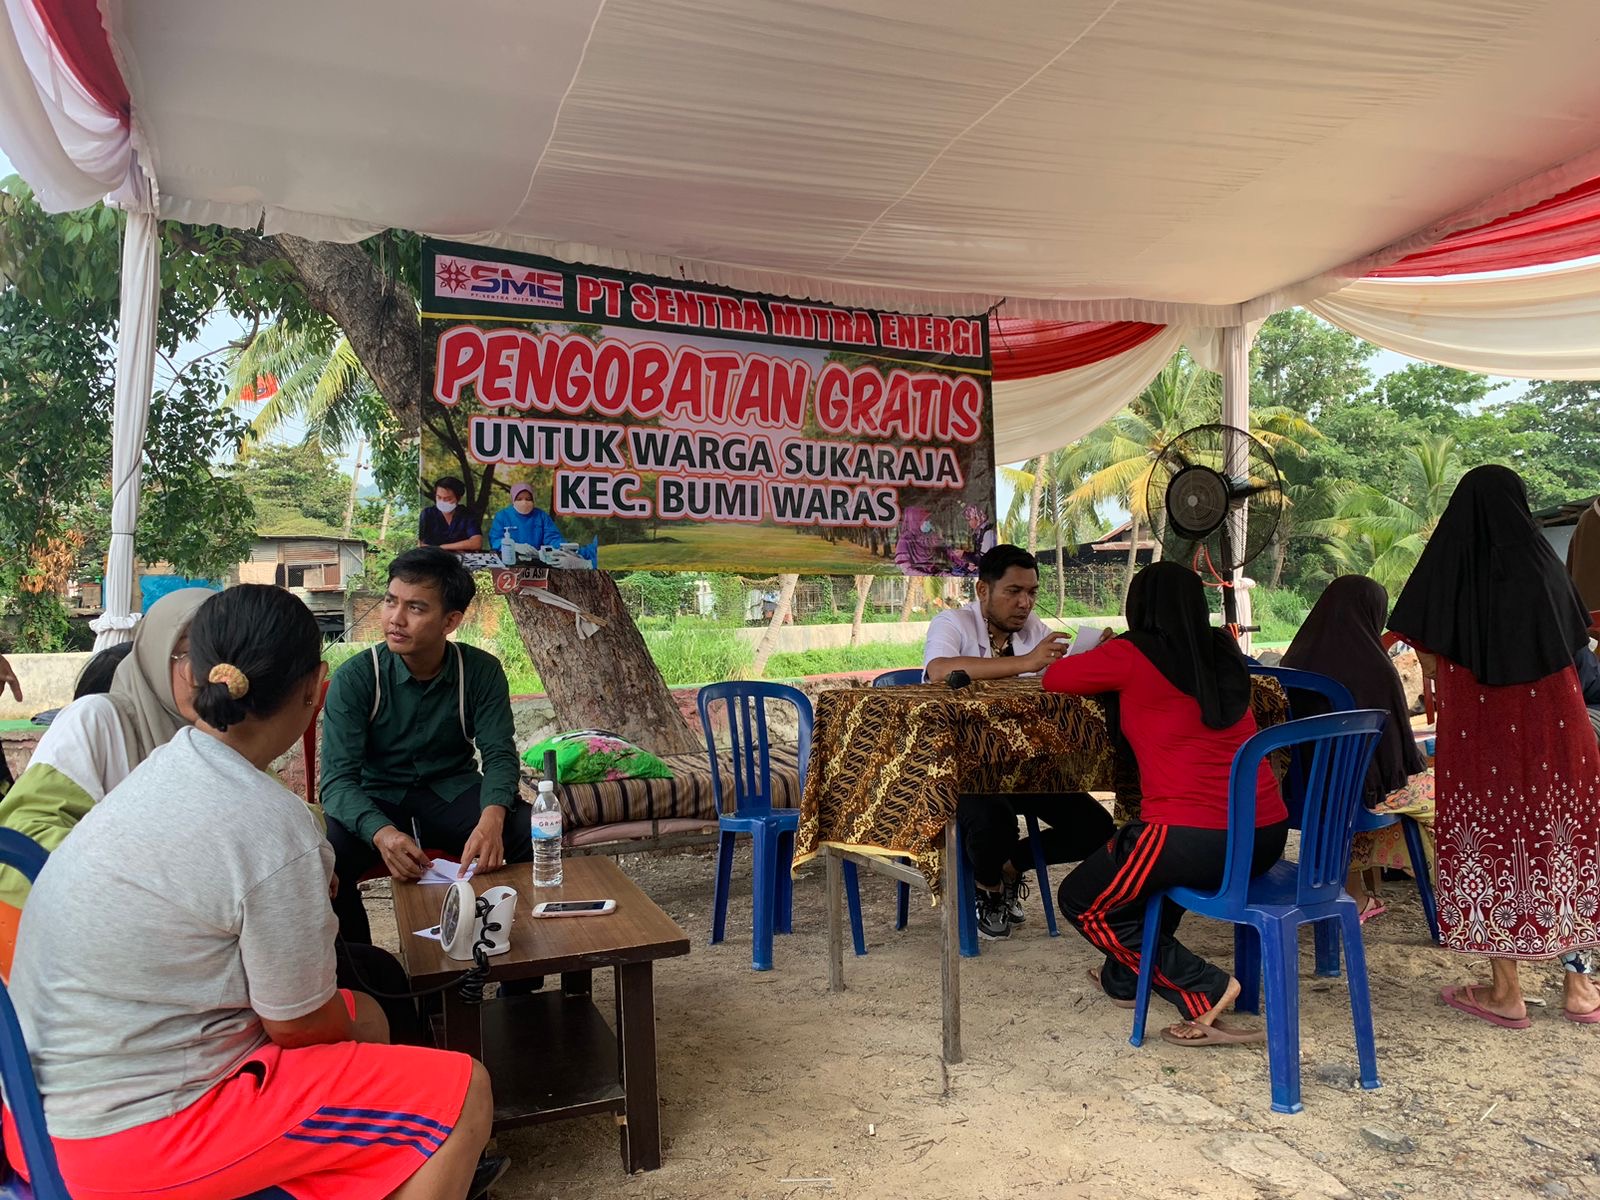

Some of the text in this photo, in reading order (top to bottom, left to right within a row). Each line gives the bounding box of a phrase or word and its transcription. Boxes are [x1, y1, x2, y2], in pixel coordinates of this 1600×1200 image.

[470, 265, 562, 301] SME
[576, 275, 983, 358] PT SENTRA MITRA ENERGI
[438, 328, 981, 440] PENGOBATAN GRATIS
[474, 421, 959, 483] UNTUK WARGA SUKARAJA
[560, 474, 897, 522] KEC. BUMI WARAS
[502, 574, 511, 589] 2
